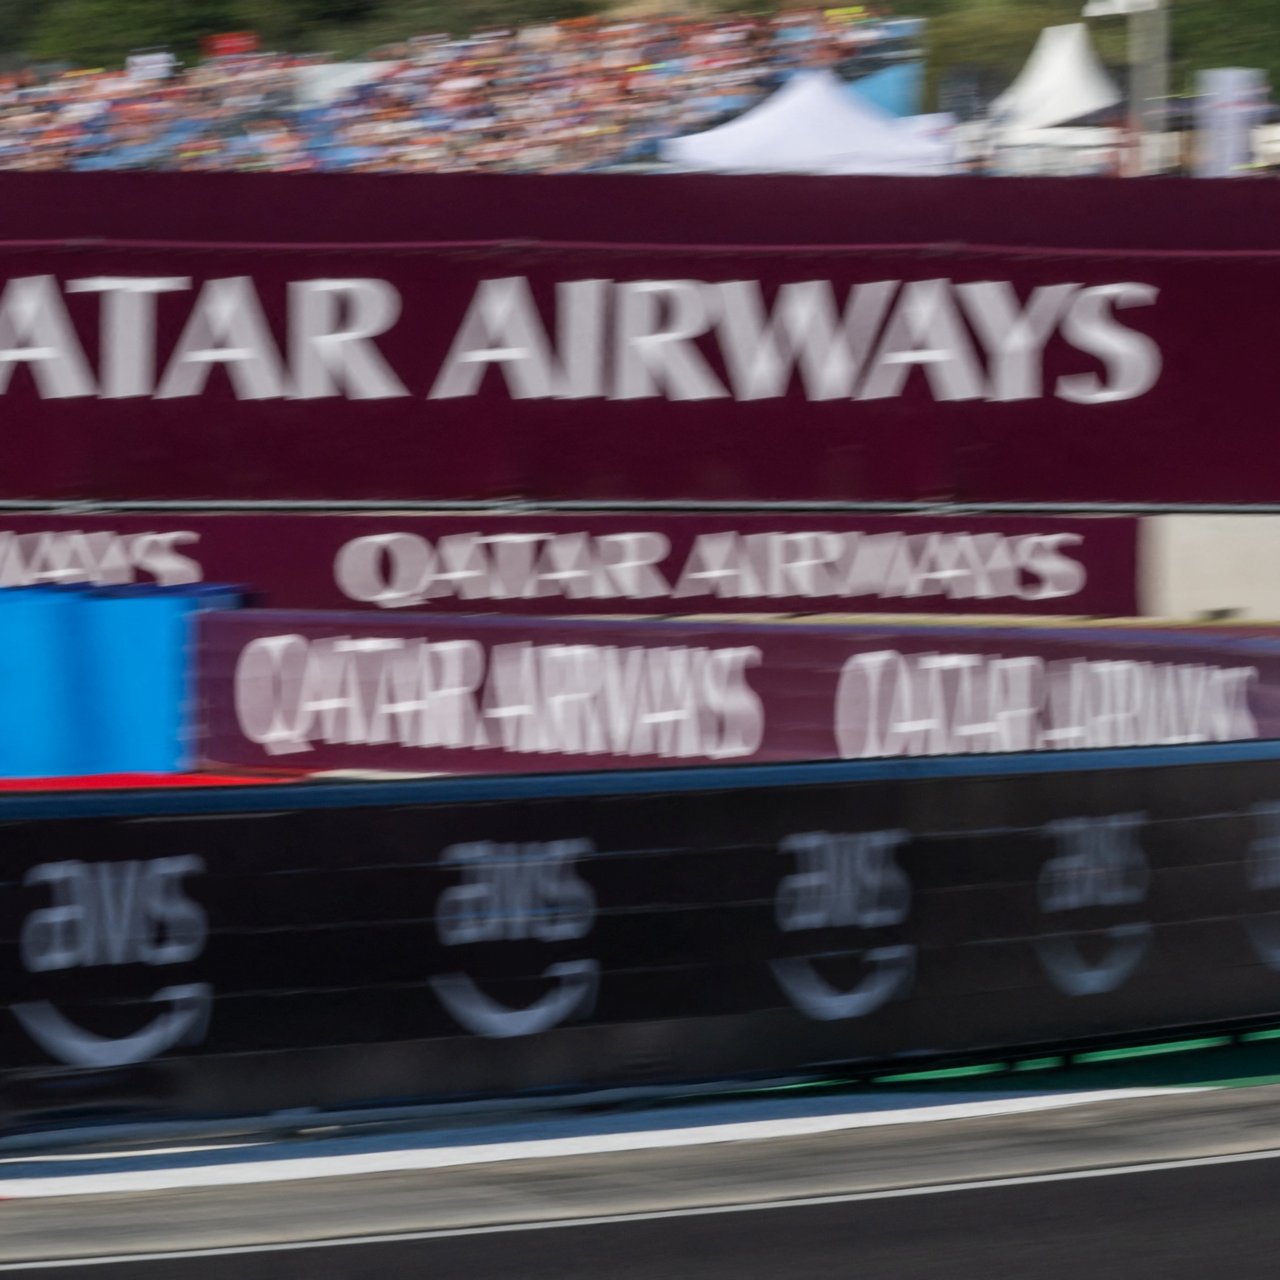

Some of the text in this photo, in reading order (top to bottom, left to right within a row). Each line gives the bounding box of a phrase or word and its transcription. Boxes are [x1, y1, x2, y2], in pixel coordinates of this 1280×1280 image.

[428, 276, 1162, 405] AIRWAYS
[334, 531, 1087, 608] QATAR AIRWAYS
[234, 634, 764, 759] QATAR AIRWAYS
[20, 854, 209, 973] aws
[435, 837, 597, 945] aws
[776, 829, 912, 932] aws
